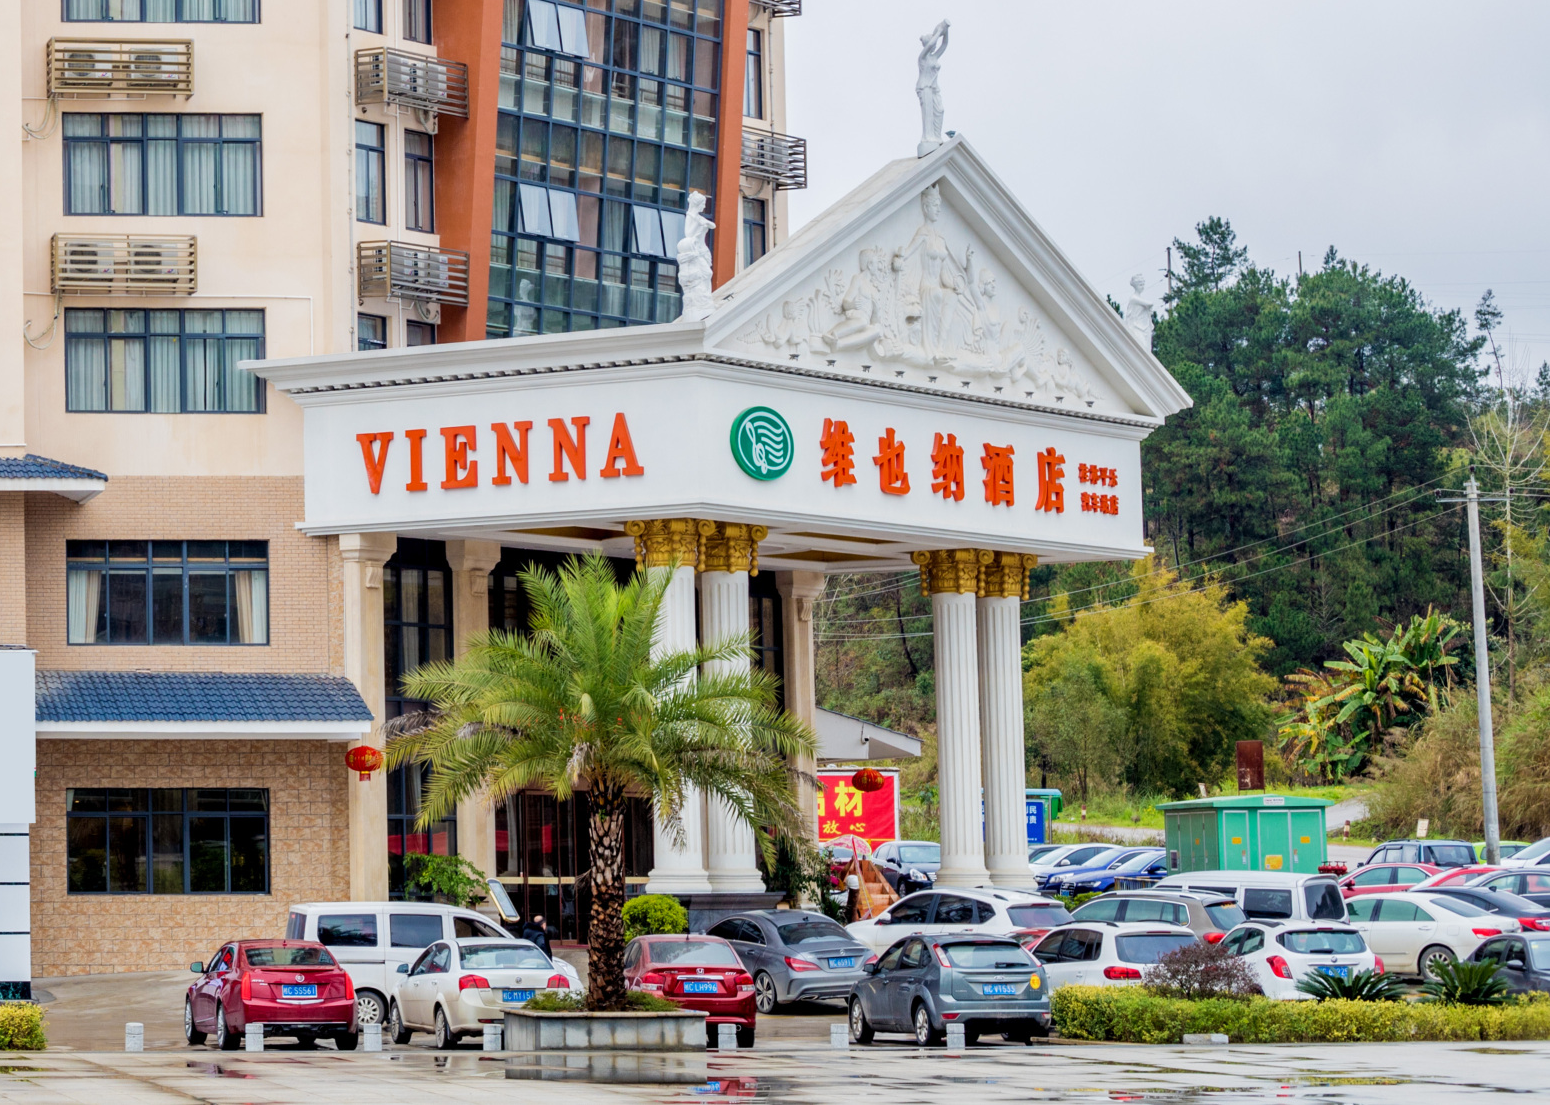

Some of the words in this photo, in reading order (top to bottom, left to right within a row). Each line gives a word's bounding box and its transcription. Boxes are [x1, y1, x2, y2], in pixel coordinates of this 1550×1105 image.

[355, 412, 645, 495] VIENNA
[819, 417, 1066, 514] 维也纳酒店
